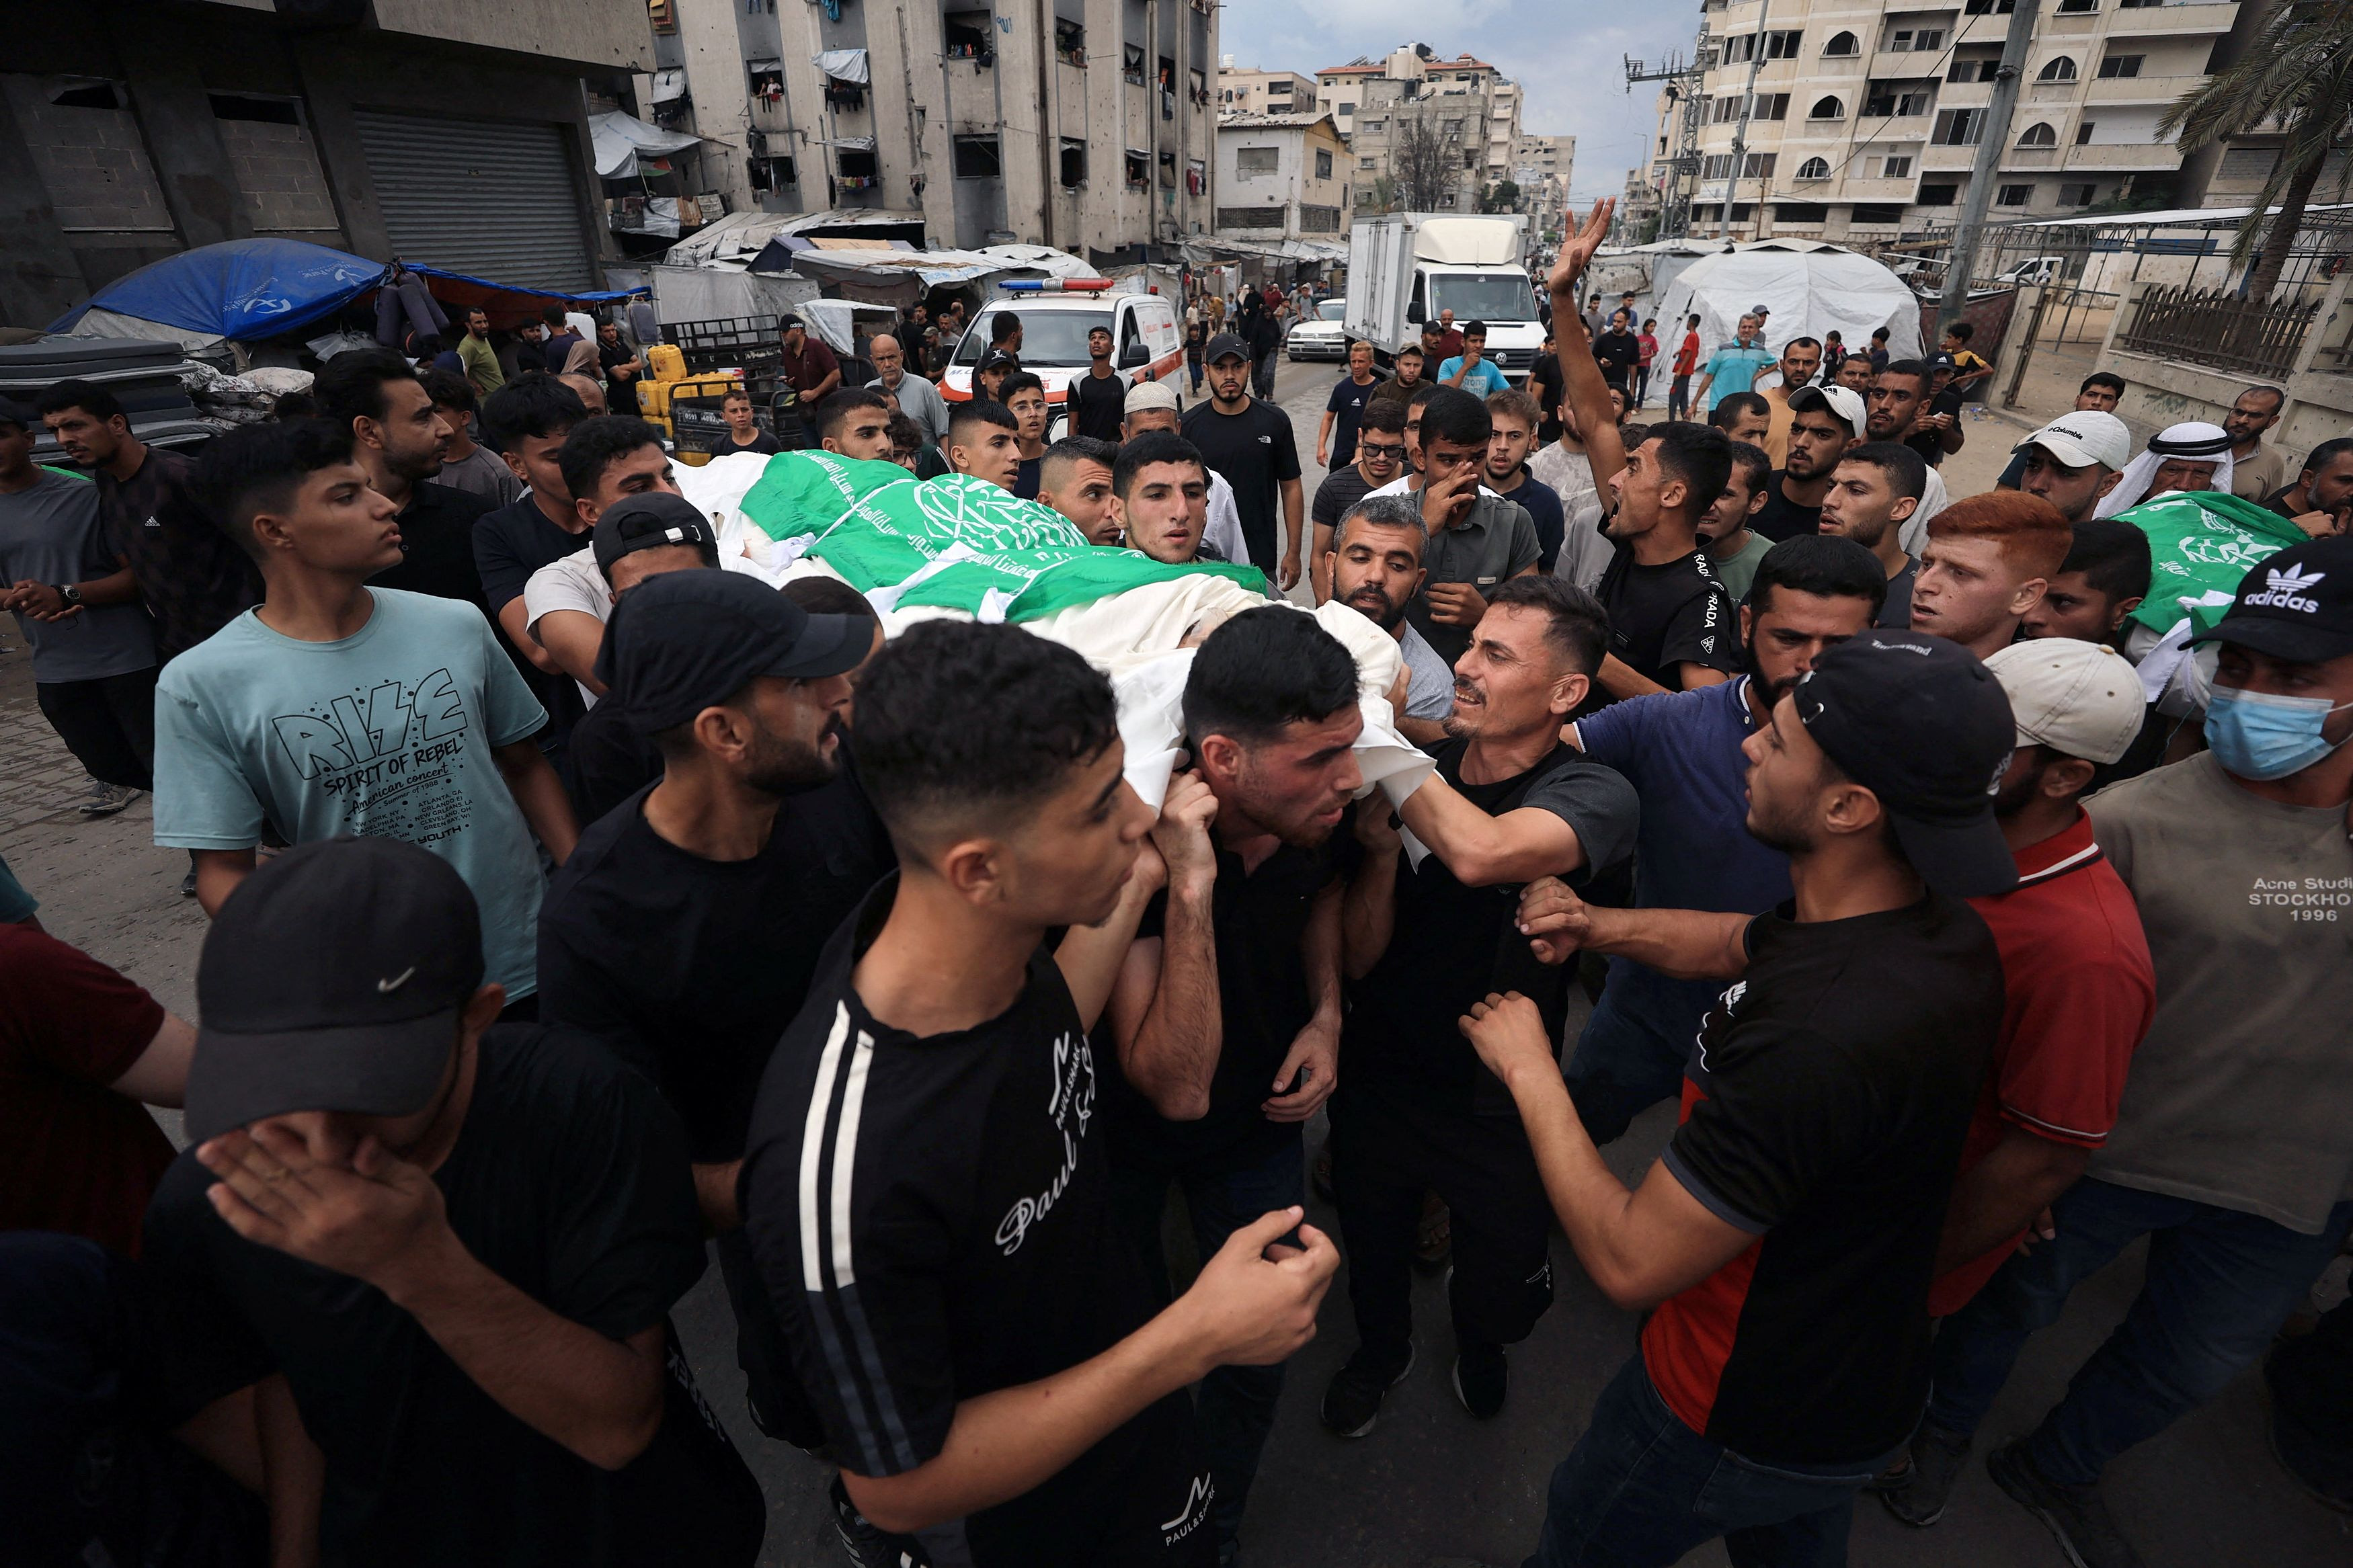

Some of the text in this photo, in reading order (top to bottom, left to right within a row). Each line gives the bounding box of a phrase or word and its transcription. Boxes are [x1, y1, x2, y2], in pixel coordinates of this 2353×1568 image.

[2052, 426, 2083, 440] Columbia
[1704, 591, 1718, 628] PRADA
[2244, 590, 2319, 613] adidas
[272, 668, 469, 780] RISE
[324, 737, 464, 796] SPIRIT OF REBEL
[347, 761, 450, 816] American concert
[383, 780, 439, 807] Summer of 1988
[414, 813, 432, 823] NEW
[419, 824, 463, 845] YOUTH
[2253, 877, 2353, 890] Acne Studi
[2248, 893, 2353, 906] STOCKHO
[2290, 909, 2338, 921] 1996
[995, 1129, 1076, 1256] Paul
